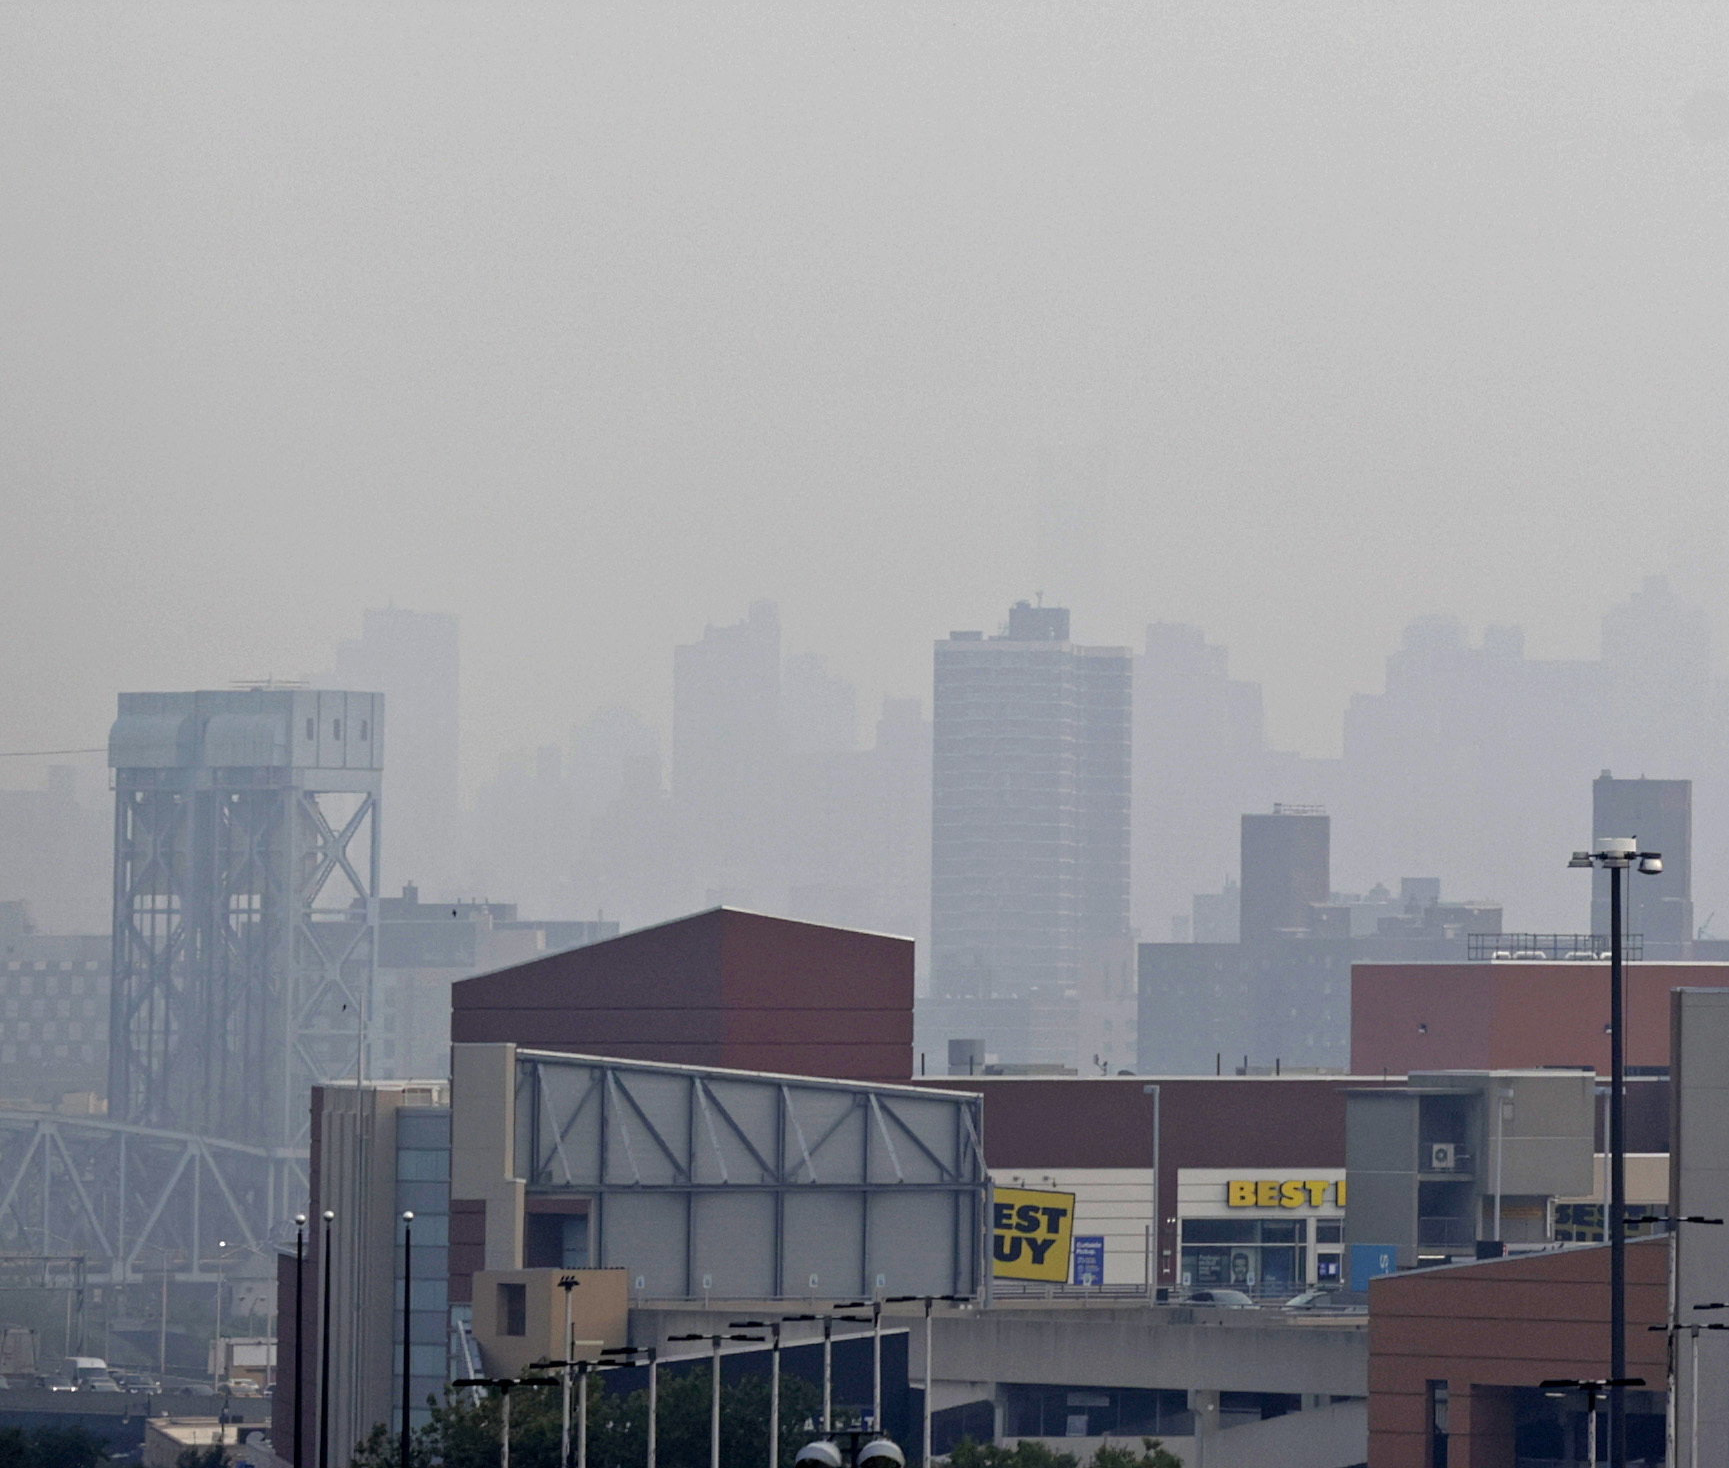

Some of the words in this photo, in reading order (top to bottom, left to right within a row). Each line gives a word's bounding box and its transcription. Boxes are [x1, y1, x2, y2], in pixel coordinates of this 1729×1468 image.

[1227, 1180, 1330, 1208] BEST
[993, 1203, 1067, 1234] EST
[1555, 1203, 1647, 1231] BET
[993, 1235, 1056, 1265] UY
